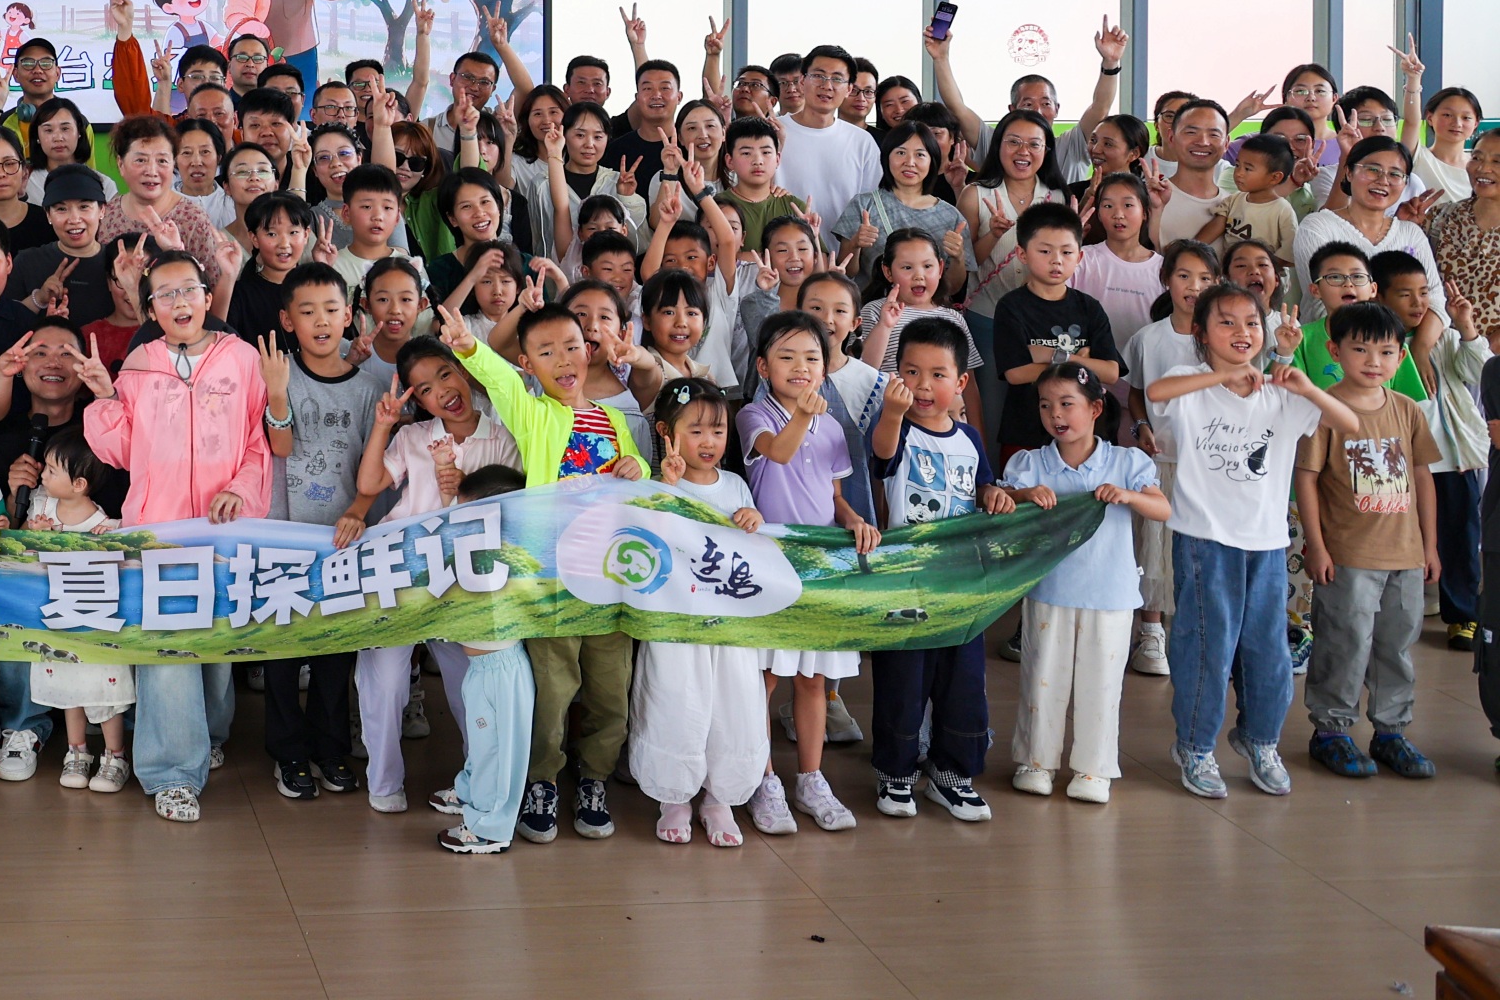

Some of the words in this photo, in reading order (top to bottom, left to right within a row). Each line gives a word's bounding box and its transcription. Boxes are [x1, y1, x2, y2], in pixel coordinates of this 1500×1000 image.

[1196, 436, 1249, 452] Vivacios
[38, 502, 509, 632] 夏日探鲜记
